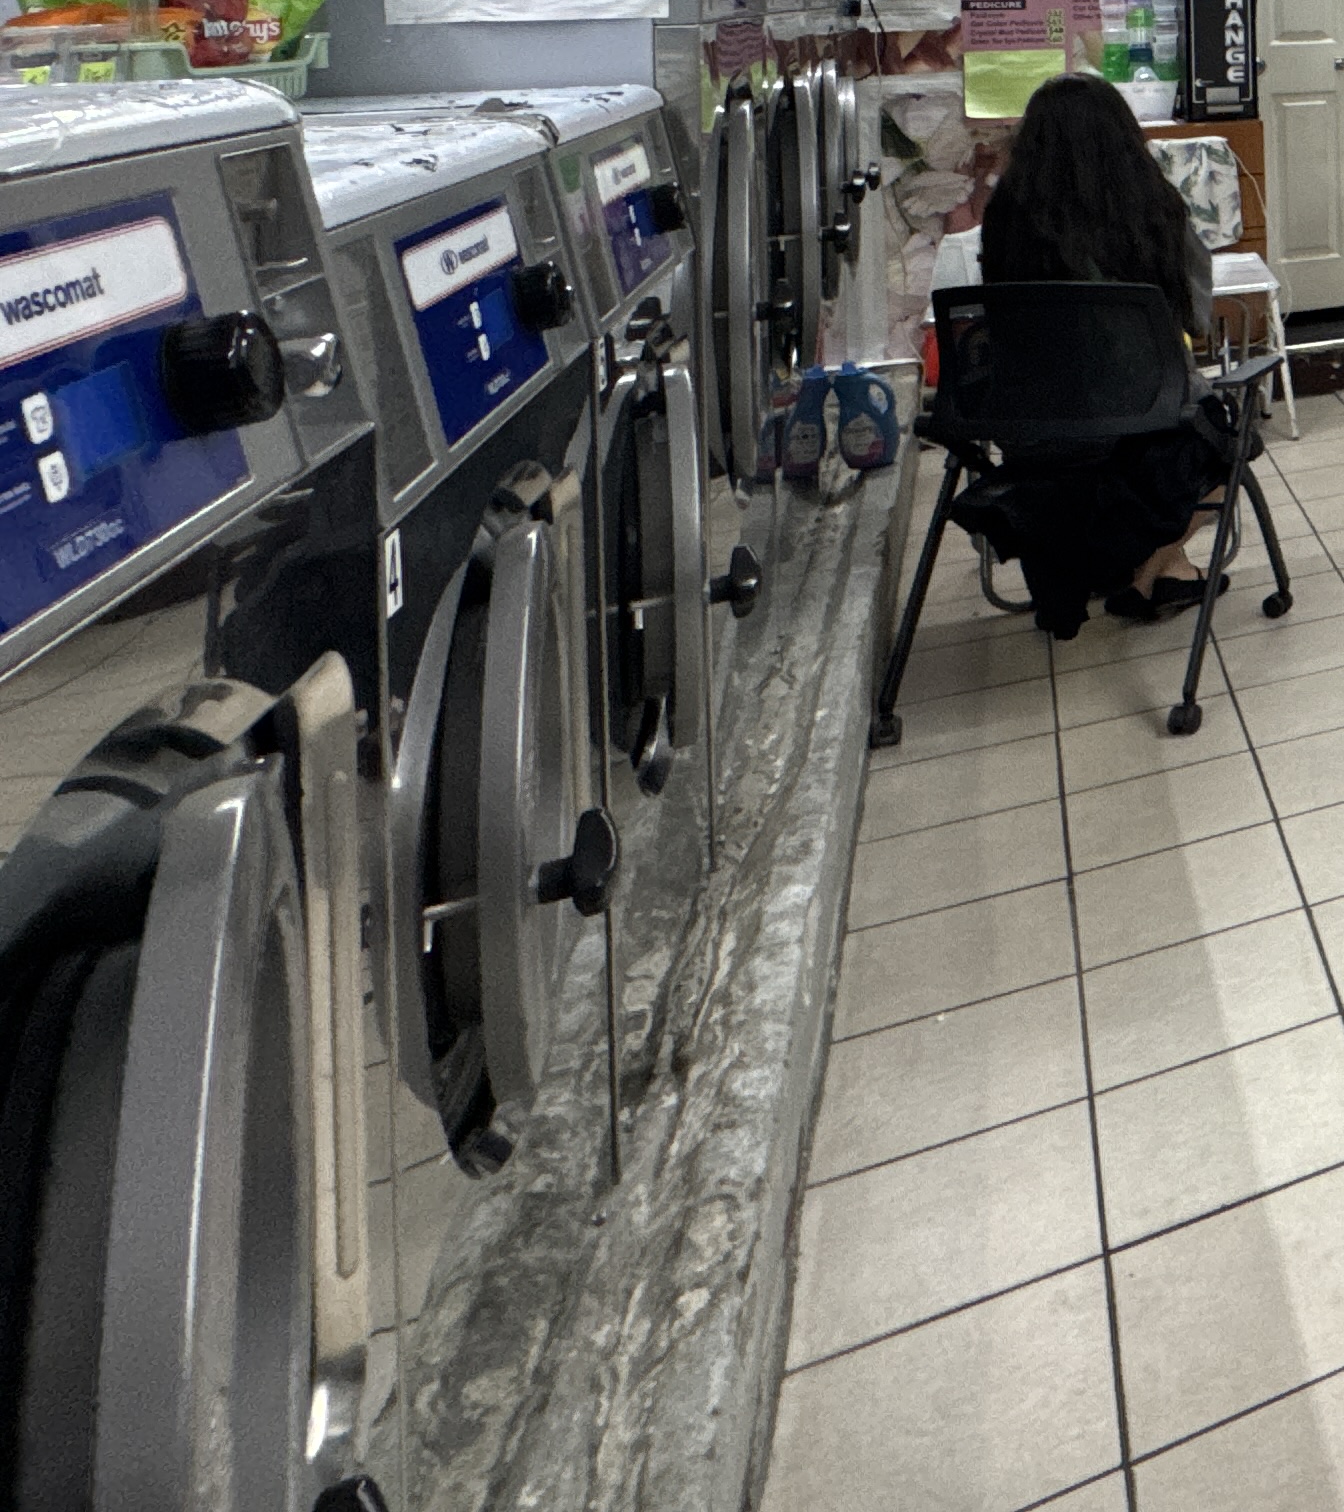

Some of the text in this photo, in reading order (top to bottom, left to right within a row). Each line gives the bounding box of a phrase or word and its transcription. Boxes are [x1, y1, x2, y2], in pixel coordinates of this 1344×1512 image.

[969, 1, 1023, 9] PEDICURE
[0, 266, 105, 326] wascomat
[389, 537, 399, 606] 4
